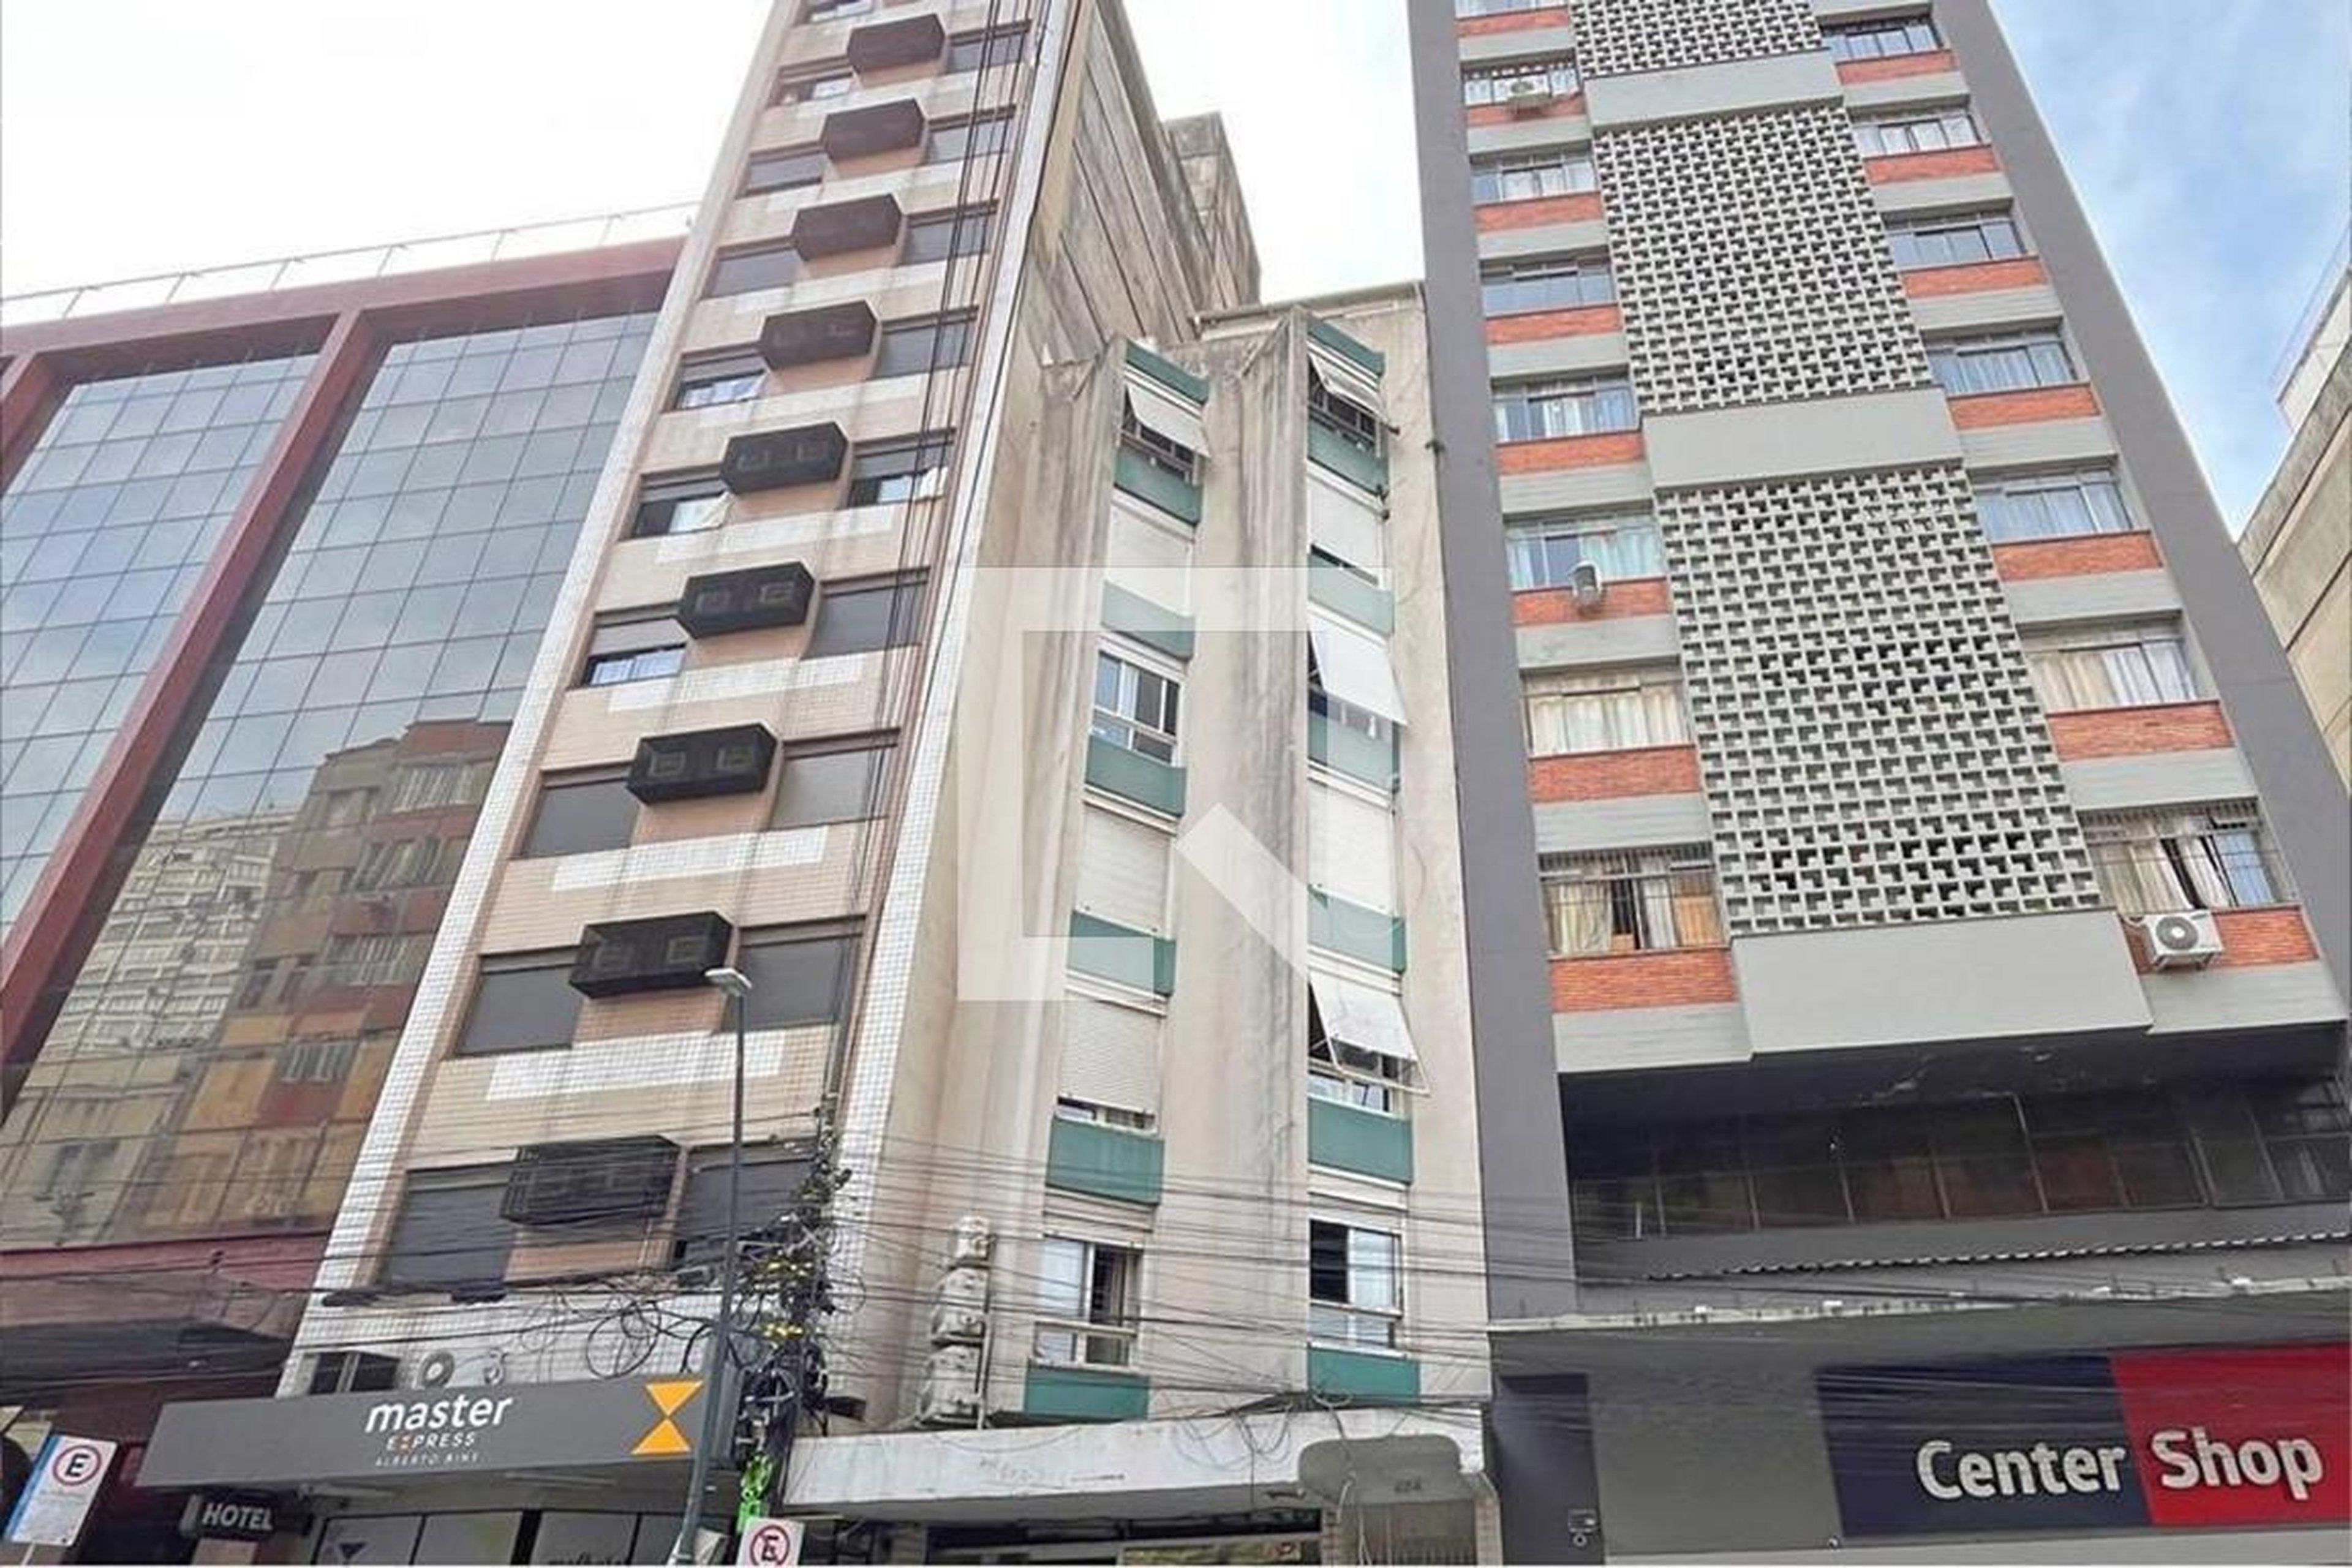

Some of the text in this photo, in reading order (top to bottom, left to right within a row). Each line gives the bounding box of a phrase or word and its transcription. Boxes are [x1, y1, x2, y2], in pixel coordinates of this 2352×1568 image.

[364, 1394, 513, 1433] master
[1916, 1427, 2323, 1500] Center Shop
[202, 1502, 273, 1531] HOTEL
